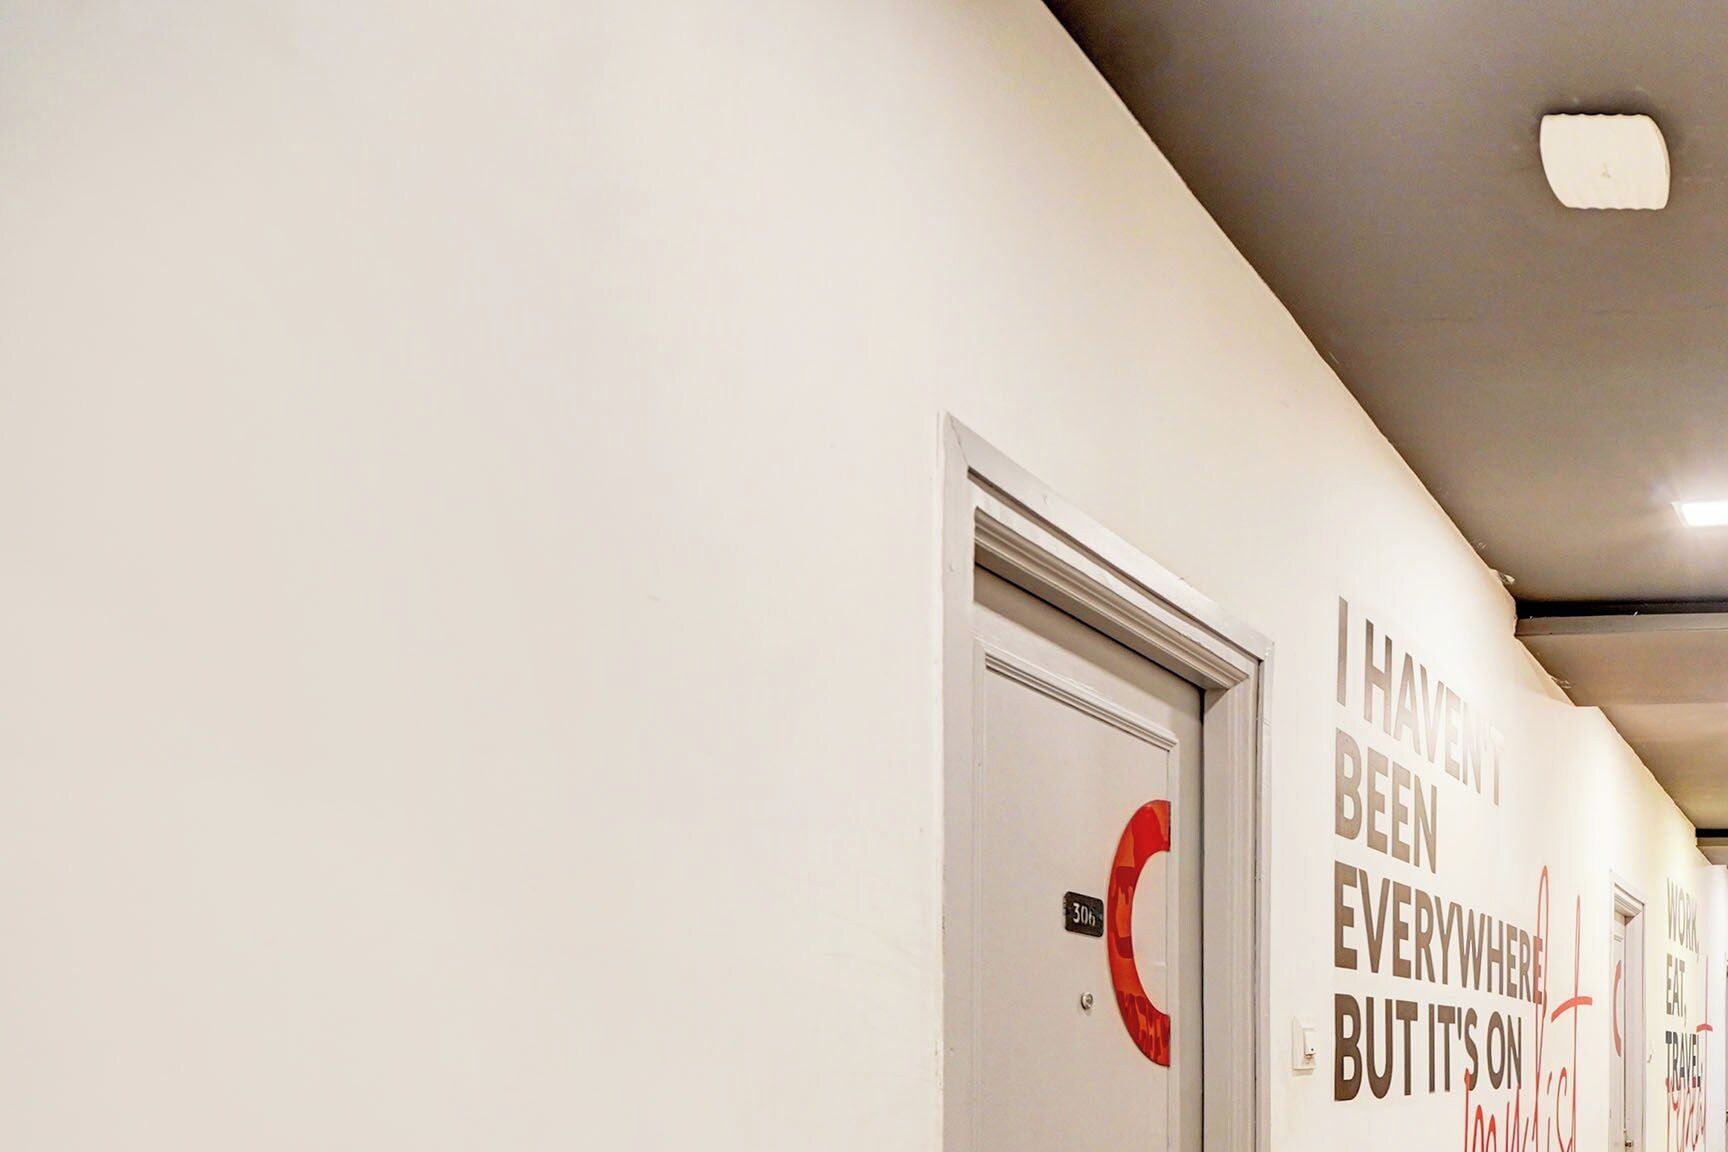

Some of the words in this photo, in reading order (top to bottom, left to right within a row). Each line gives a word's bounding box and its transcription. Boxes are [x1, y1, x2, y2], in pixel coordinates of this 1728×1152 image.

[1336, 595, 1348, 707] I
[1363, 619, 1505, 806] HAVEN'T
[1334, 726, 1437, 874] BEEN
[1334, 992, 1418, 1102] BUT
[1429, 1002, 1478, 1094] IT'S
[1487, 1010, 1522, 1090] ON
